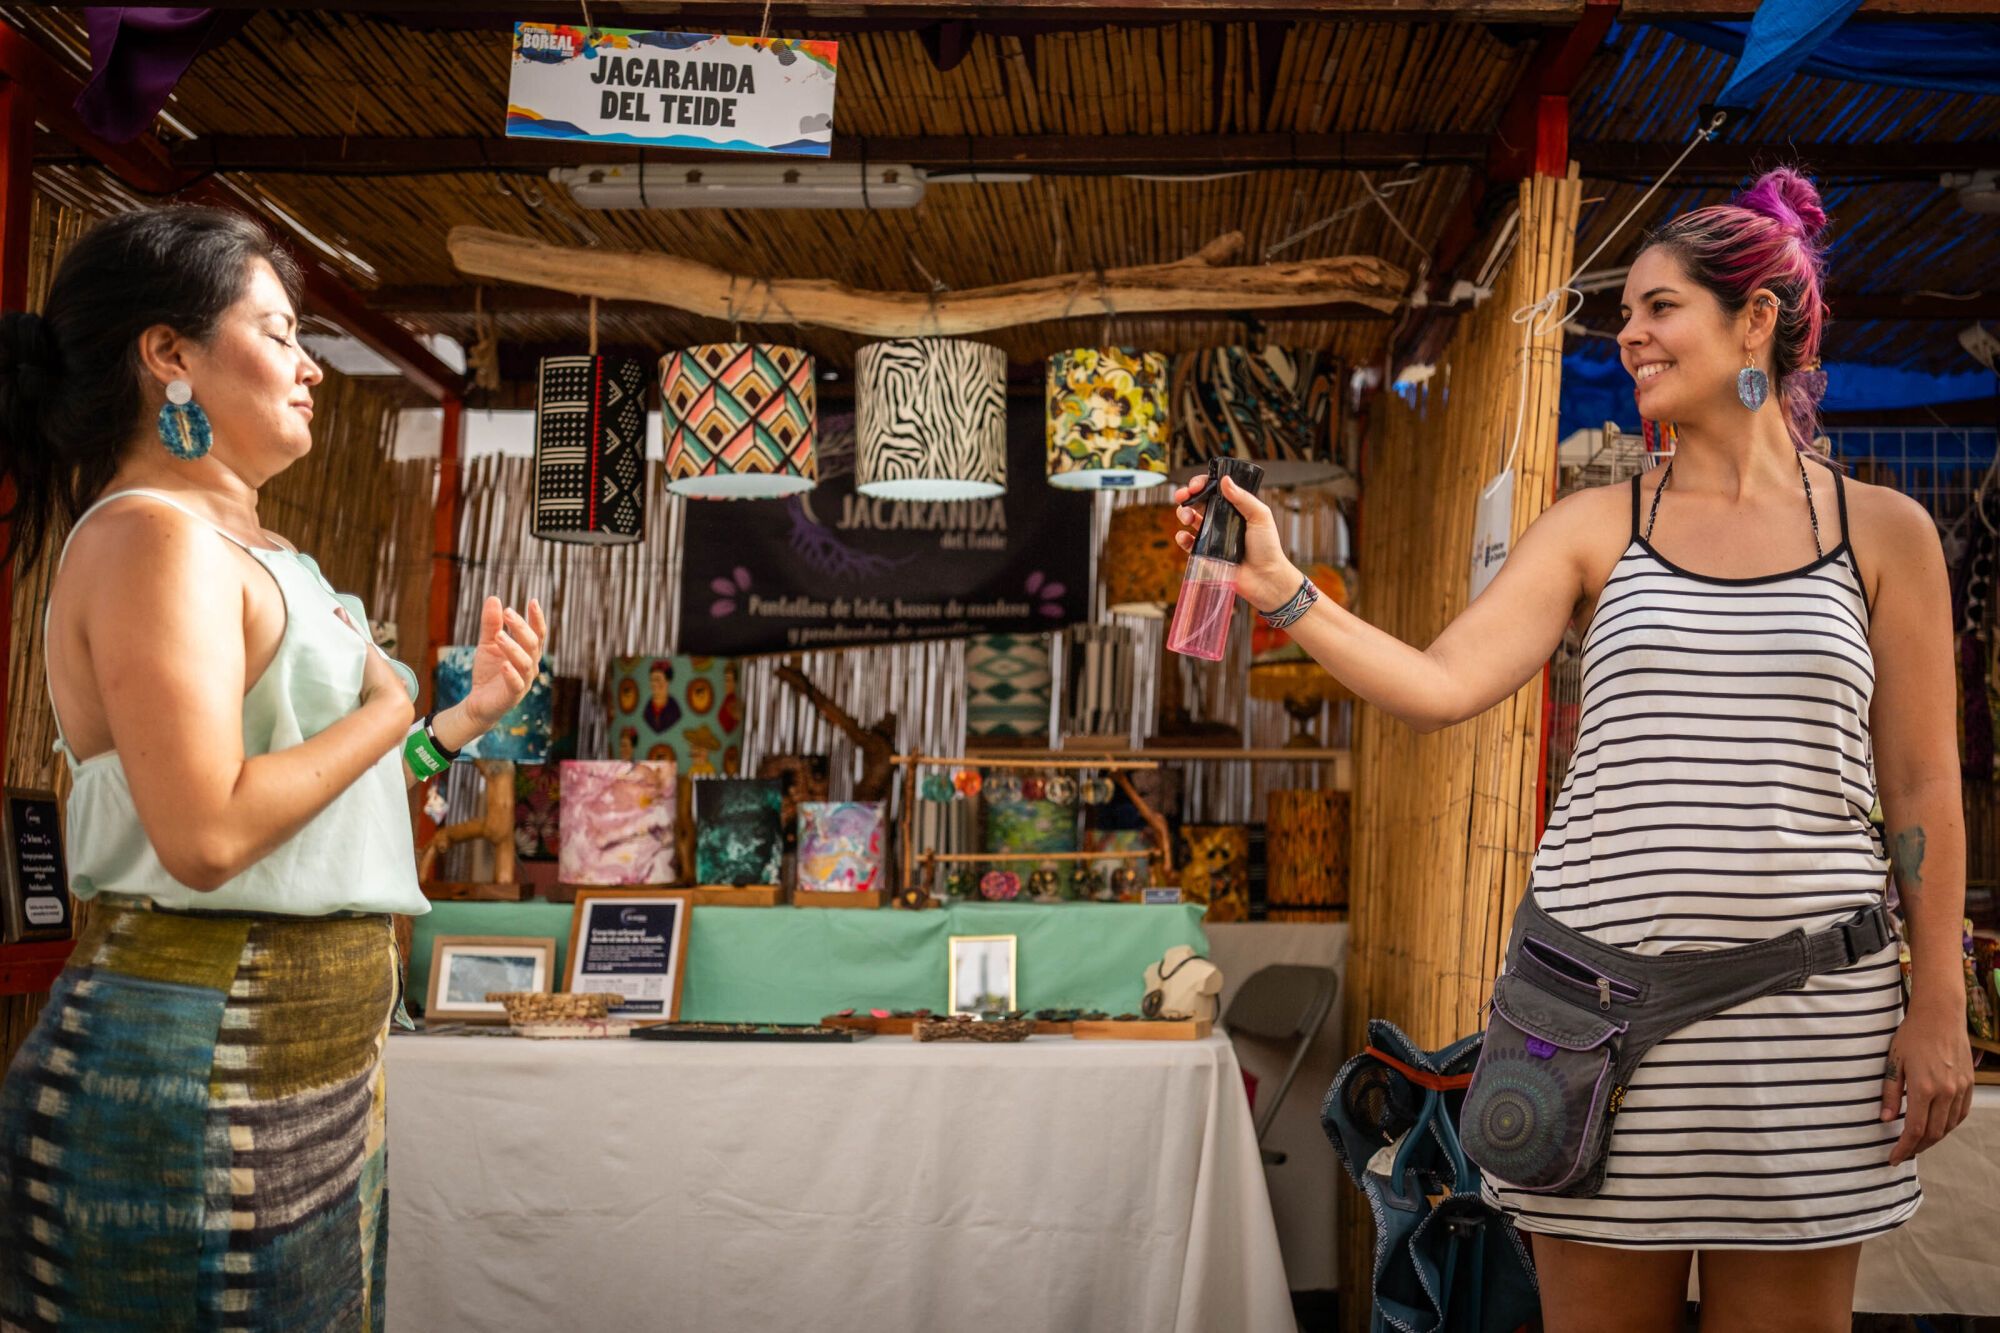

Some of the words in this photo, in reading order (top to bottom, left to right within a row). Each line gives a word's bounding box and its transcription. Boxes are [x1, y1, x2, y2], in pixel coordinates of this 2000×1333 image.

[523, 33, 575, 51] BOREAL
[590, 55, 756, 94] JACARANDA
[600, 90, 650, 122] DEL
[660, 94, 738, 127] TEIDE
[836, 494, 1007, 530] JACARANDA
[830, 597, 850, 617] de
[943, 599, 964, 618] de
[415, 745, 440, 772] BOREAL
